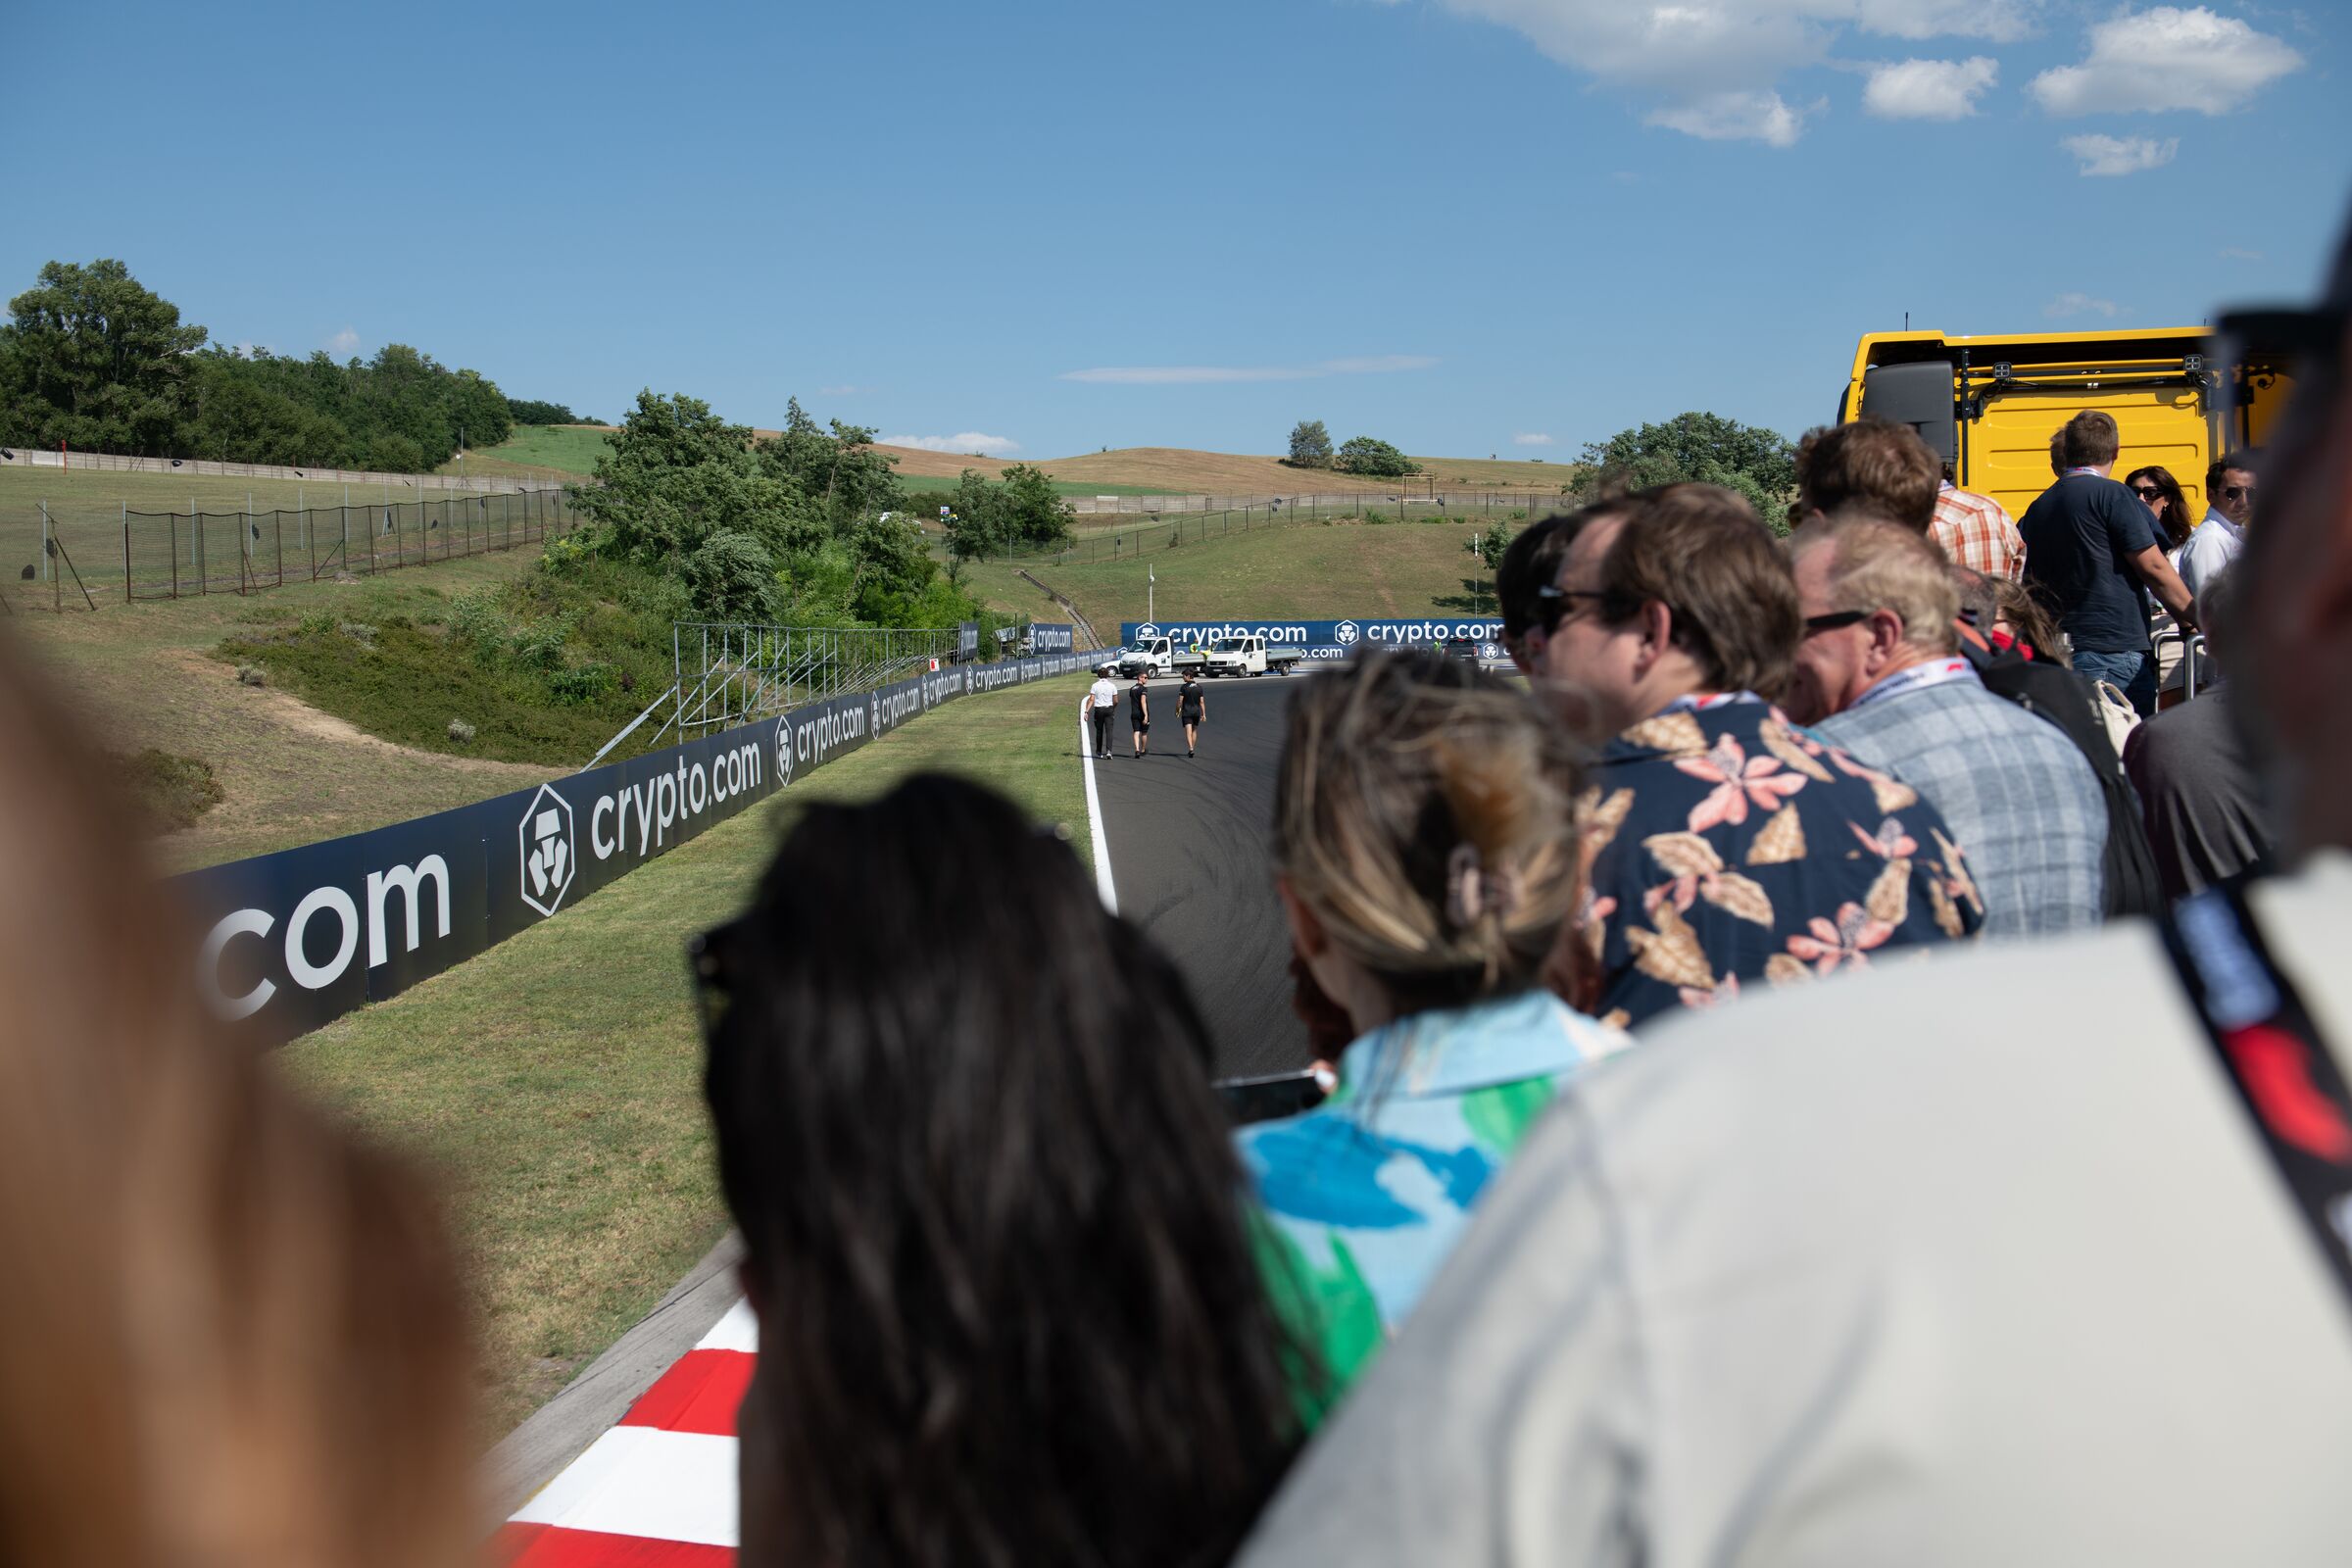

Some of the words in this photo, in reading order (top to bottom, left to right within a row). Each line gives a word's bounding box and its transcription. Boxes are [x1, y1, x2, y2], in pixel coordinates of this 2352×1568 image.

[1037, 625, 1071, 652] crypto.com
[1168, 623, 1306, 645] cryptocom
[928, 672, 961, 704] crypto.com
[975, 666, 1017, 691] crypto.com
[882, 687, 919, 727] crypto.com
[797, 706, 865, 763] crypto.com
[591, 741, 761, 859] crypto.com
